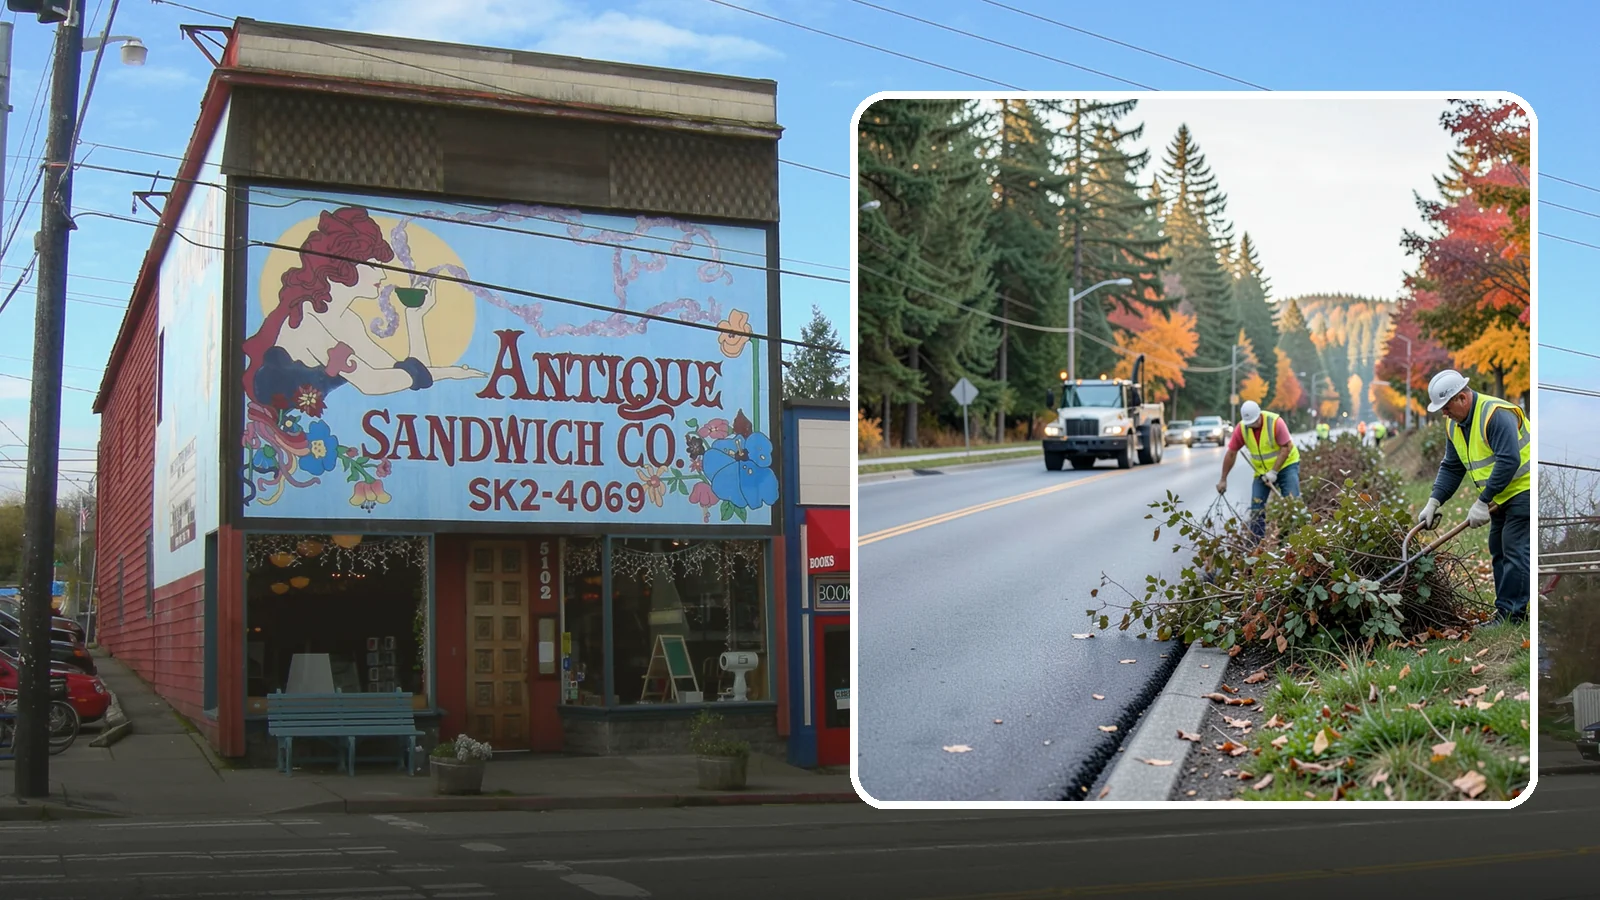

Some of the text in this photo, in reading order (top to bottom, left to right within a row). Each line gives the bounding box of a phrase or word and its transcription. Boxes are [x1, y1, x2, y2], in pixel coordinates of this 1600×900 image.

[477, 329, 723, 421] ANTIQUE
[362, 409, 685, 469] SANDWICH CO.
[468, 477, 646, 512] SK2-4069
[540, 542, 551, 599] 5102
[809, 555, 834, 569] BOOKS
